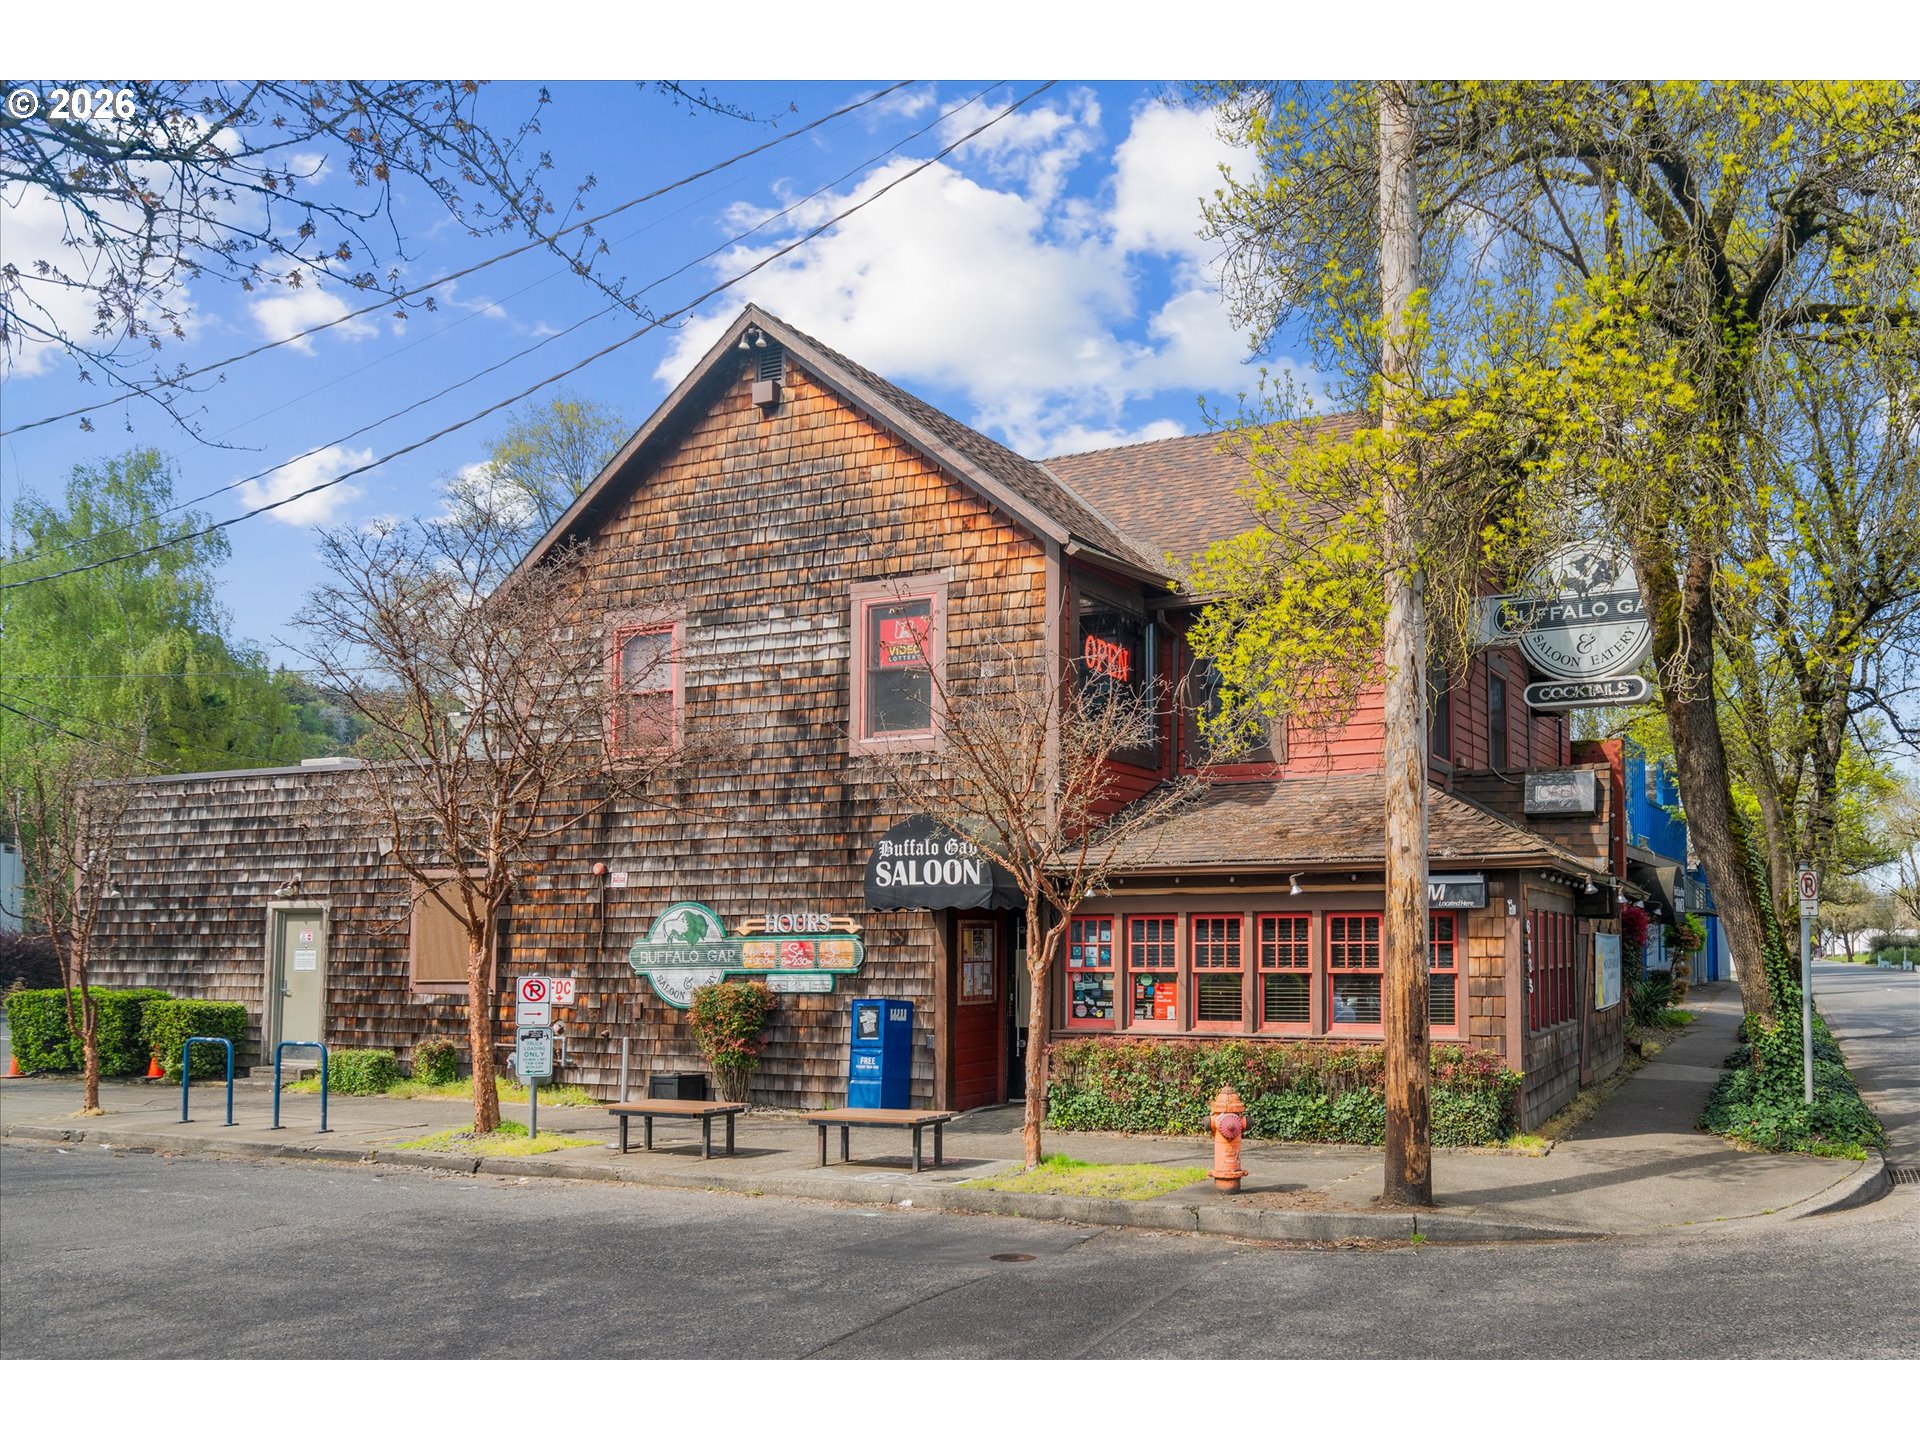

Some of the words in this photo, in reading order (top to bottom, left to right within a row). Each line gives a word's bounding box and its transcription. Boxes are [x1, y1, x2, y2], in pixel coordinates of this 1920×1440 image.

[1504, 601, 1609, 625] UFFALO
[1617, 599, 1644, 615] GA
[889, 645, 920, 656] VIDEO
[1085, 634, 1129, 682] OPEN
[1533, 633, 1582, 668] SALOON
[1590, 626, 1636, 666] EATERY
[1538, 681, 1631, 701] COCKTAILS
[878, 838, 939, 860] Buffalo
[875, 858, 981, 887] SALOON
[764, 913, 831, 933] HOURS
[639, 950, 699, 965] BUFFALO
[707, 949, 736, 963] GAP
[656, 974, 686, 1001] SALOON
[860, 1056, 876, 1065] FREE
